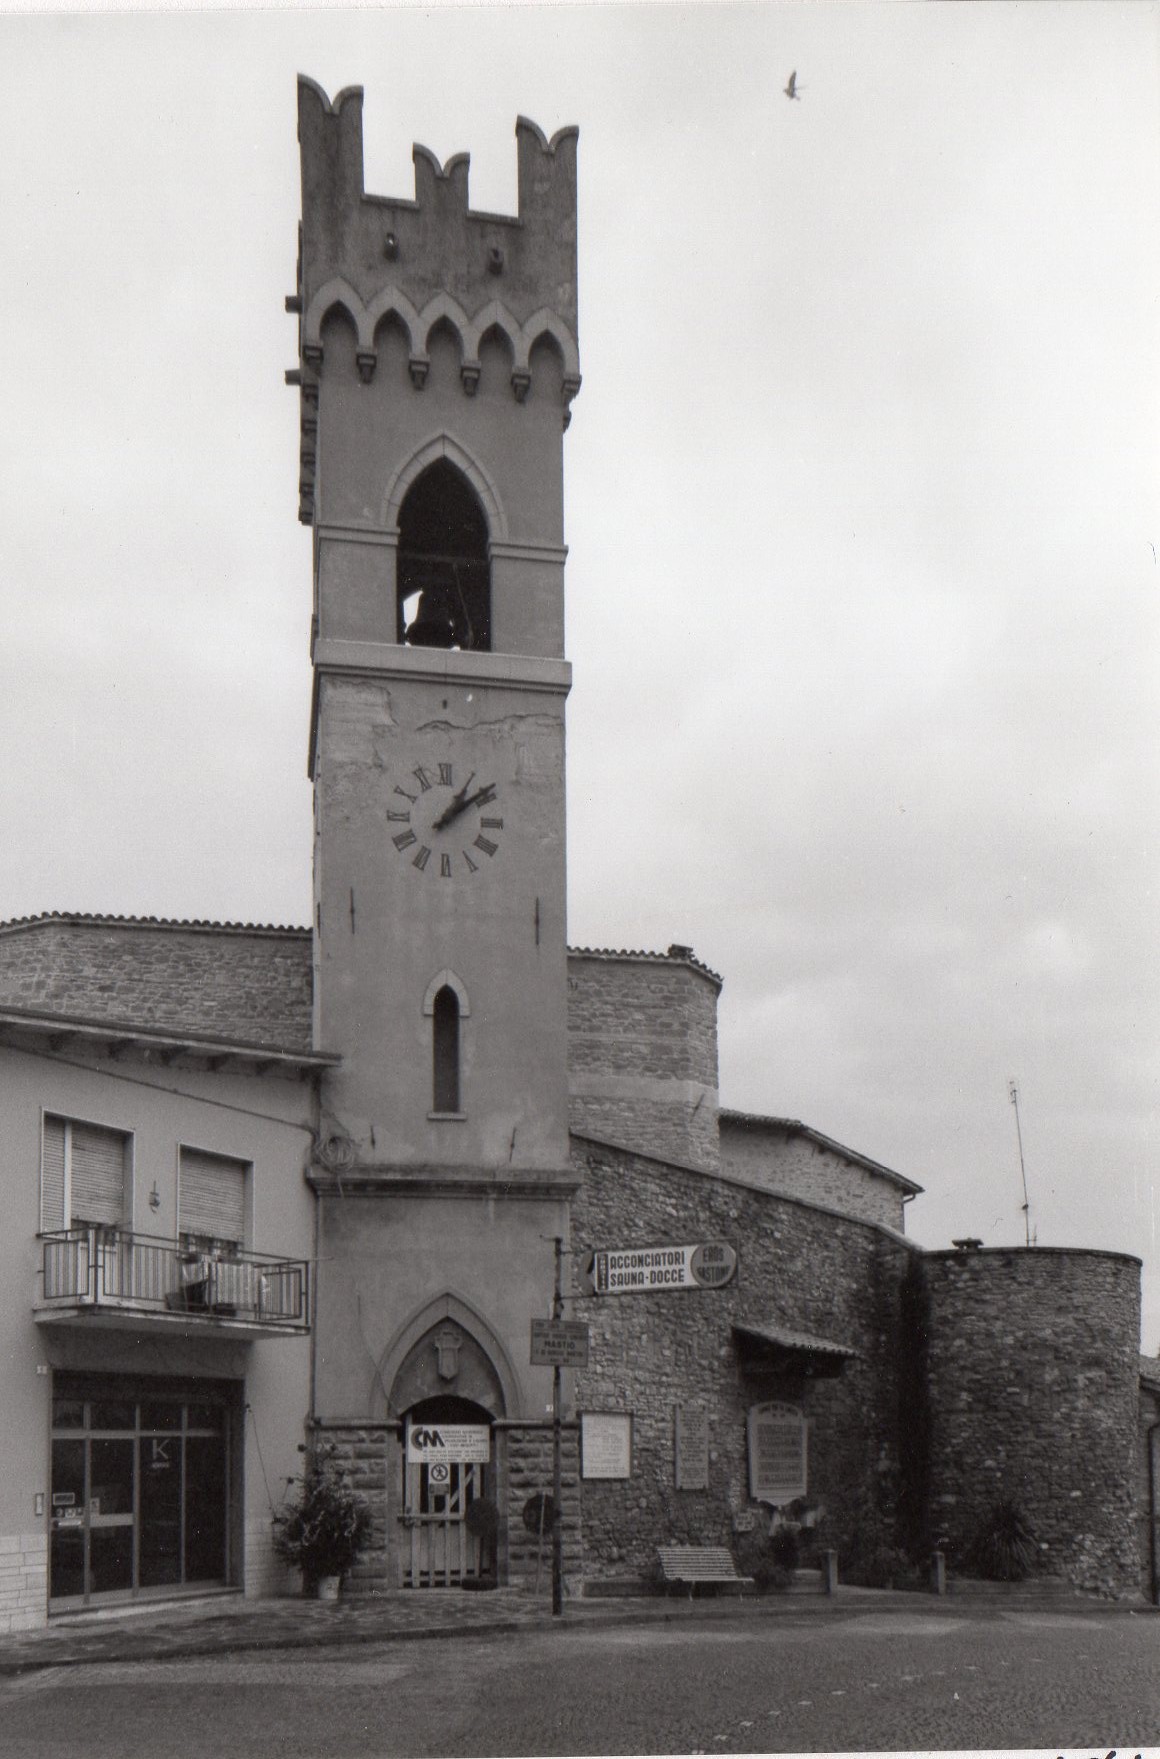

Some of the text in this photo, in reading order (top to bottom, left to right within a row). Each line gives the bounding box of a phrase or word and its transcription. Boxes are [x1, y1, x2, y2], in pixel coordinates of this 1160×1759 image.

[438, 763, 453, 786] XII
[393, 785, 418, 804] X
[610, 1251, 685, 1269] ACCONCIATORI
[544, 1339, 576, 1350] MASTIO
[411, 1426, 446, 1451] CM
[152, 1438, 171, 1461] K
